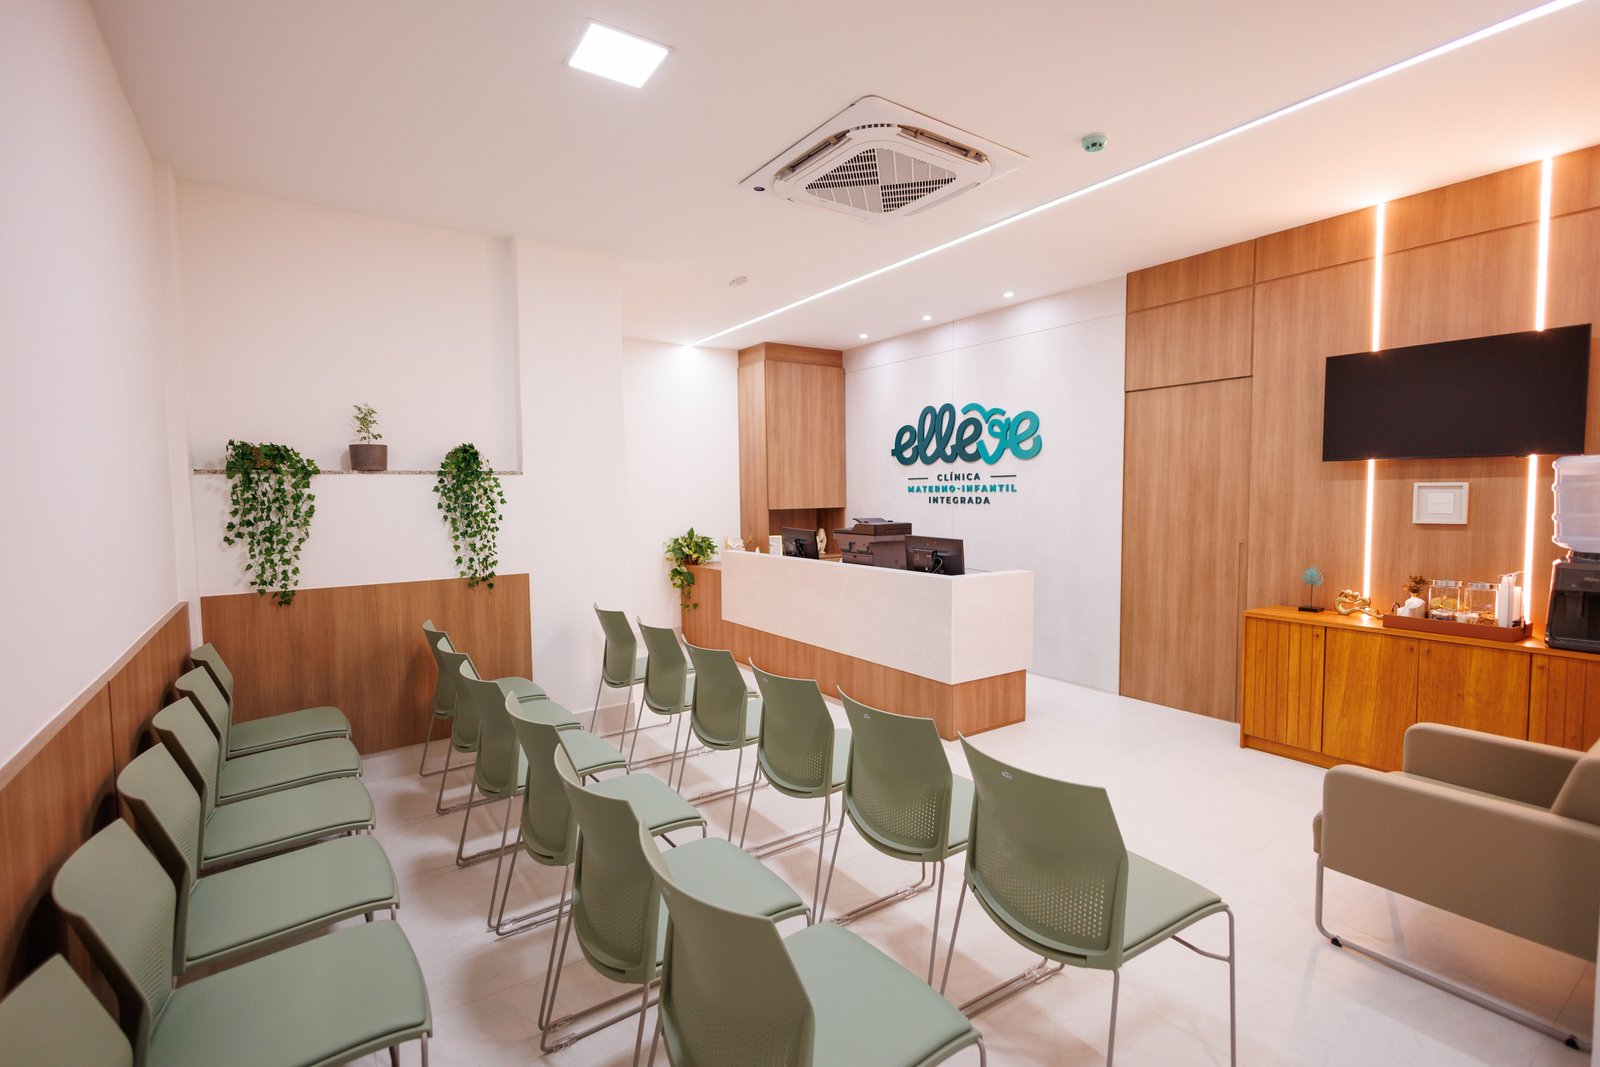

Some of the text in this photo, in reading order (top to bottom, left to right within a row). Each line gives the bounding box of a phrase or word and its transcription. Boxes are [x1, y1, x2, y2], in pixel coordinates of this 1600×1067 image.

[937, 472, 981, 482] CLÍNICA
[907, 484, 1017, 493] MATERNO-INFANTIL
[928, 496, 990, 505] INTEGRADA
